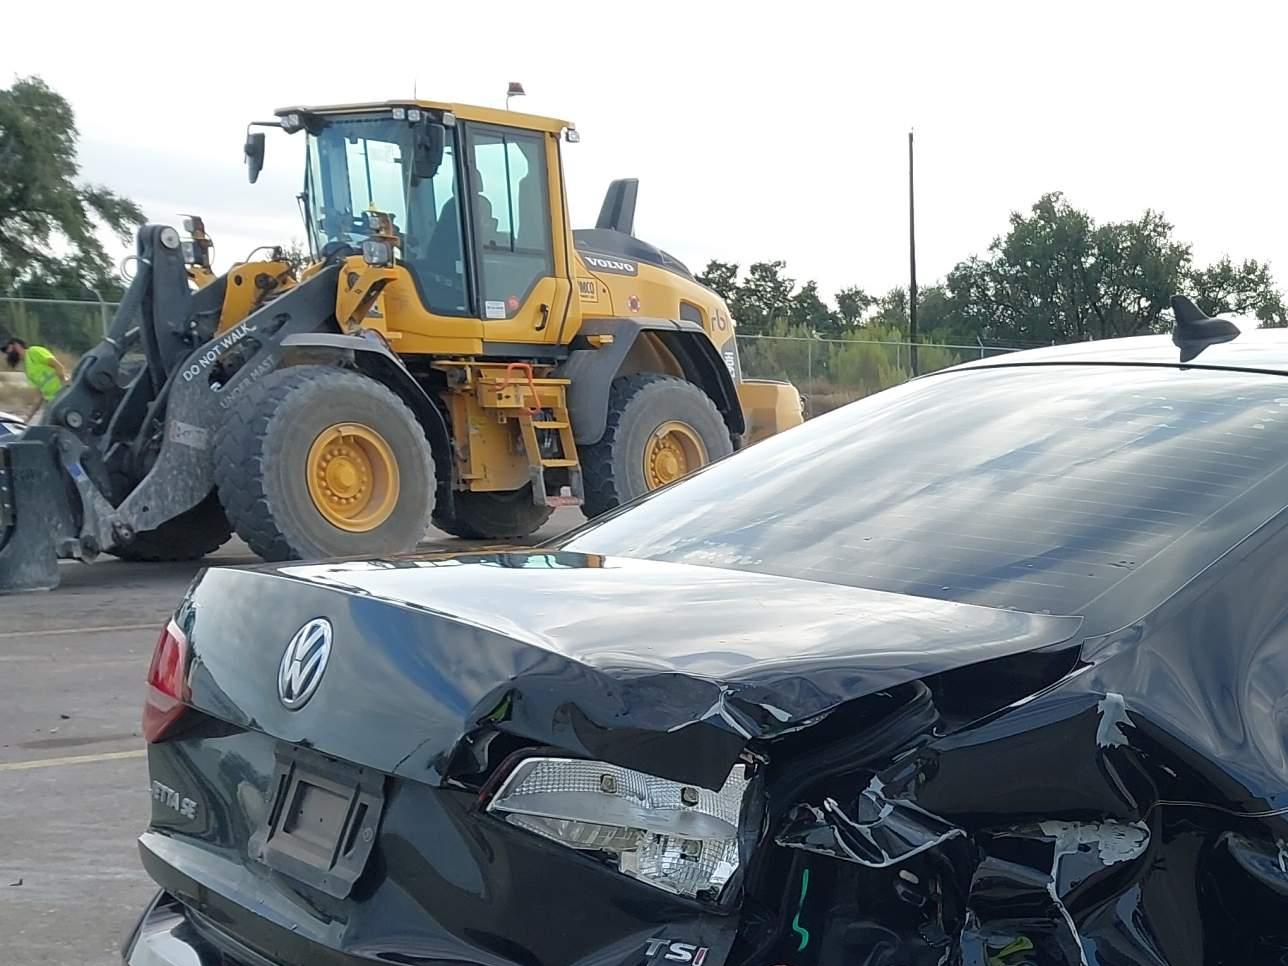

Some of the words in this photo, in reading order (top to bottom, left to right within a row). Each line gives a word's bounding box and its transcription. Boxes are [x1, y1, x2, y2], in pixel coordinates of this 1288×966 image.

[584, 256, 635, 272] VOLVO
[182, 364, 201, 382] DO
[198, 344, 222, 369] NOT
[220, 321, 257, 349] WALK
[180, 797, 199, 820] SE
